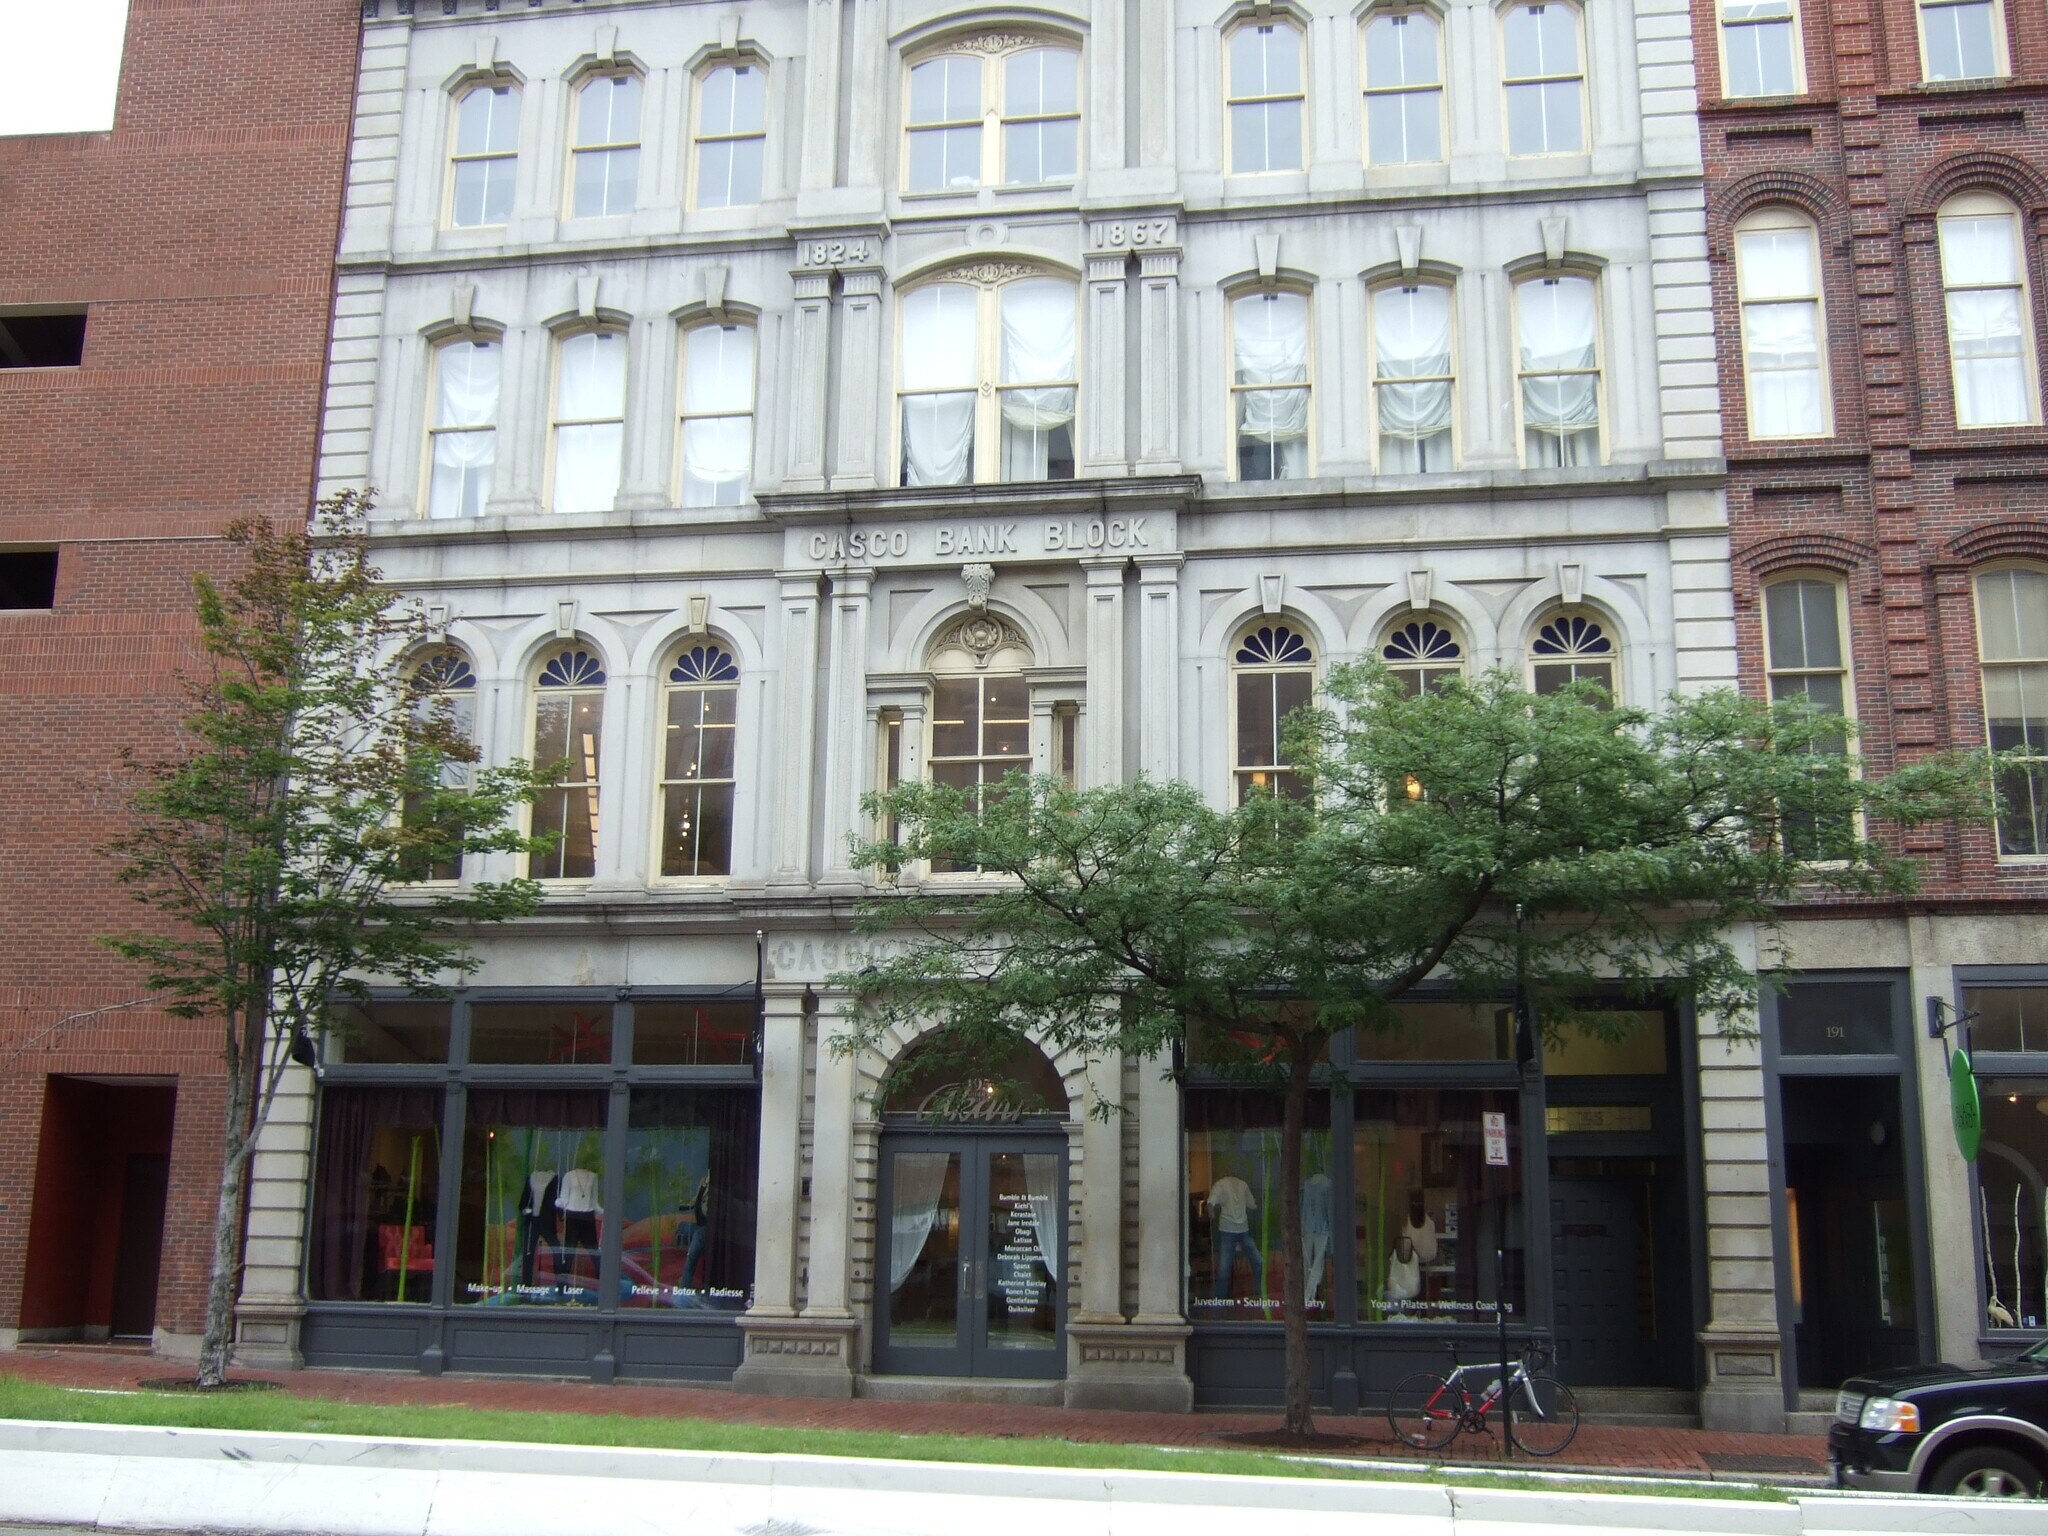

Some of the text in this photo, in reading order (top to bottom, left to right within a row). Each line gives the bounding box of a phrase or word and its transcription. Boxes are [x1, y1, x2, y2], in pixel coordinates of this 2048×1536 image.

[1097, 219, 1169, 248] 1867
[803, 240, 869, 266] 1824
[809, 518, 1149, 560] CASCO BANK BLOCK
[1826, 1026, 1845, 1038] 191
[1015, 1228, 1032, 1236] Obagi
[467, 1283, 584, 1295] Make-up Massage Laser
[631, 1285, 659, 1295] Pelleve
[672, 1286, 696, 1295] Botox
[709, 1287, 744, 1297] Radiesse
[1193, 1296, 1234, 1306] Juvederm
[1243, 1297, 1280, 1309] Sculptra
[1370, 1299, 1513, 1312] Yoga Pilates Wellness Coachng
